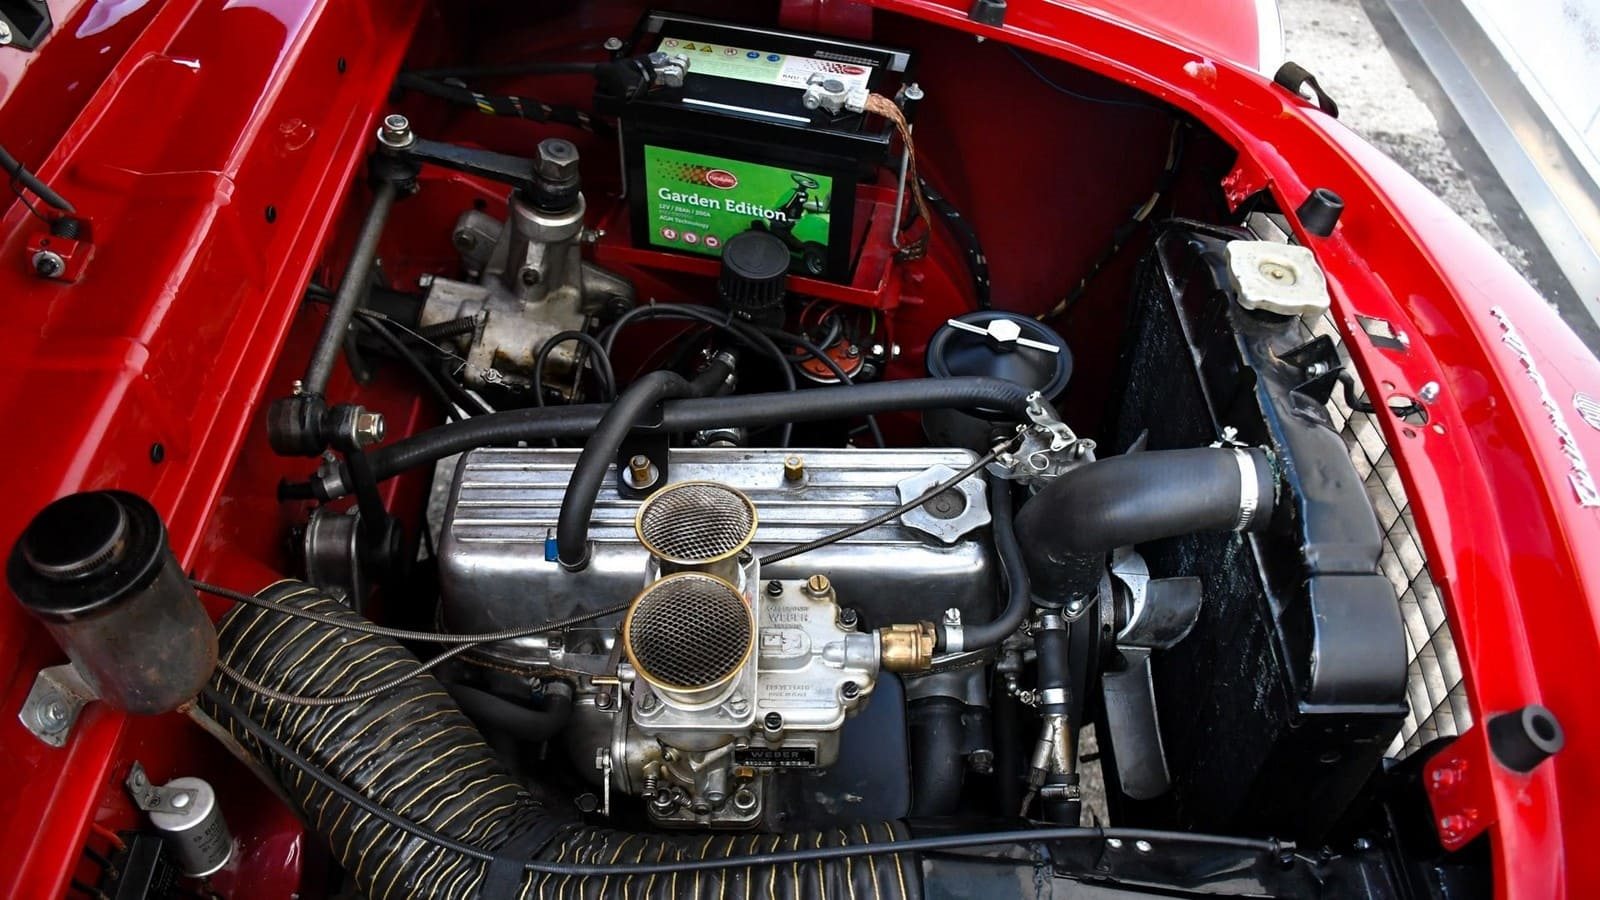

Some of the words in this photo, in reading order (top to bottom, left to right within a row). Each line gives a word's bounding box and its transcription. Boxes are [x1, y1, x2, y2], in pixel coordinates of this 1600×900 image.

[658, 187, 720, 210] Garden
[725, 199, 787, 222] Edition
[752, 751, 800, 759] WEBER
